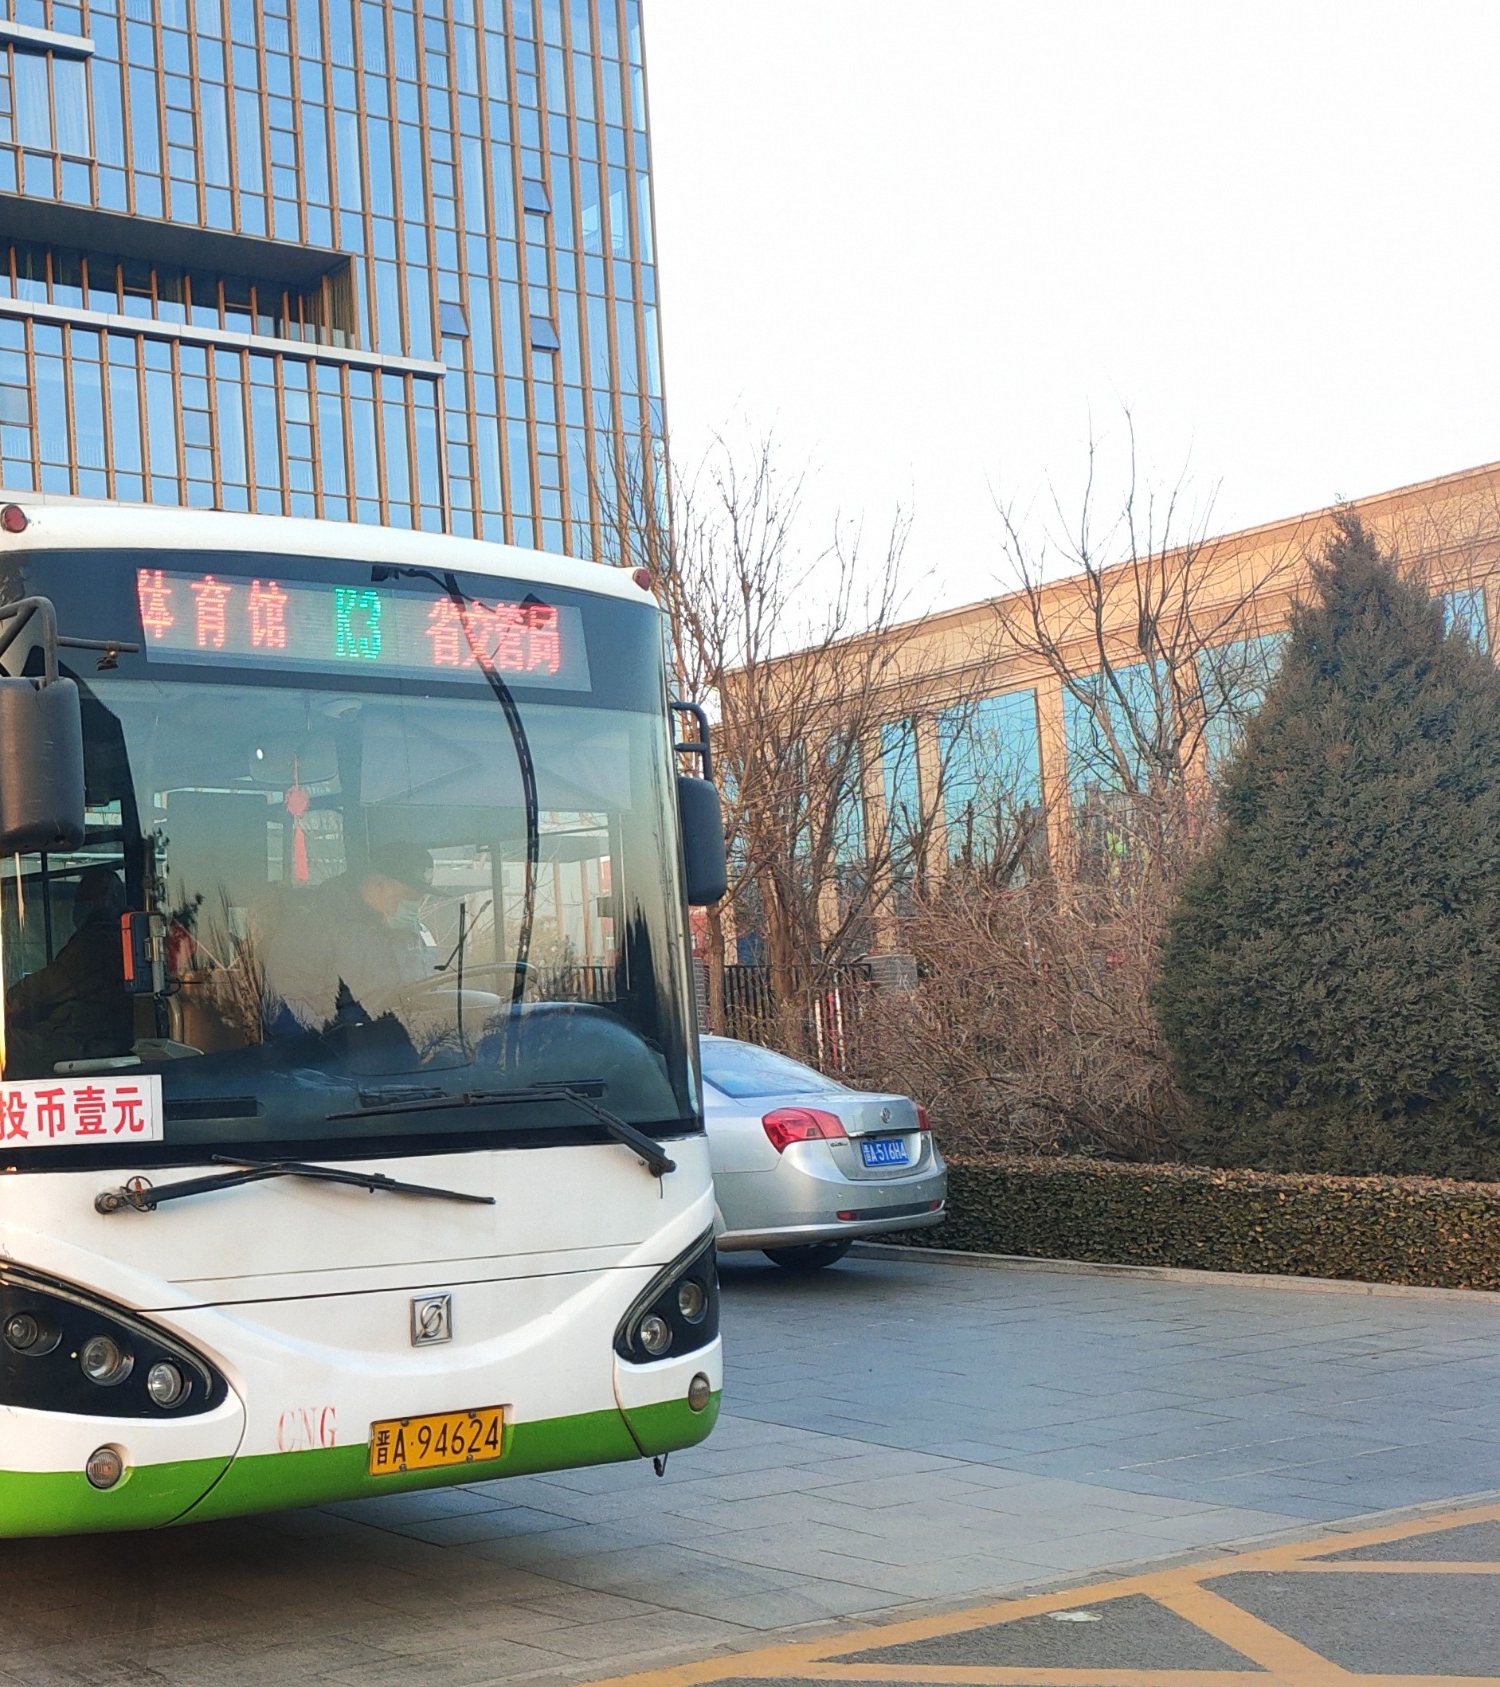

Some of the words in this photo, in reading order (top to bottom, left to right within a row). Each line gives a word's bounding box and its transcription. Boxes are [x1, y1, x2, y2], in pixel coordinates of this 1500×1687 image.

[137, 569, 288, 649] 体育馆
[335, 588, 381, 659] K3
[277, 1406, 337, 1453] CNG
